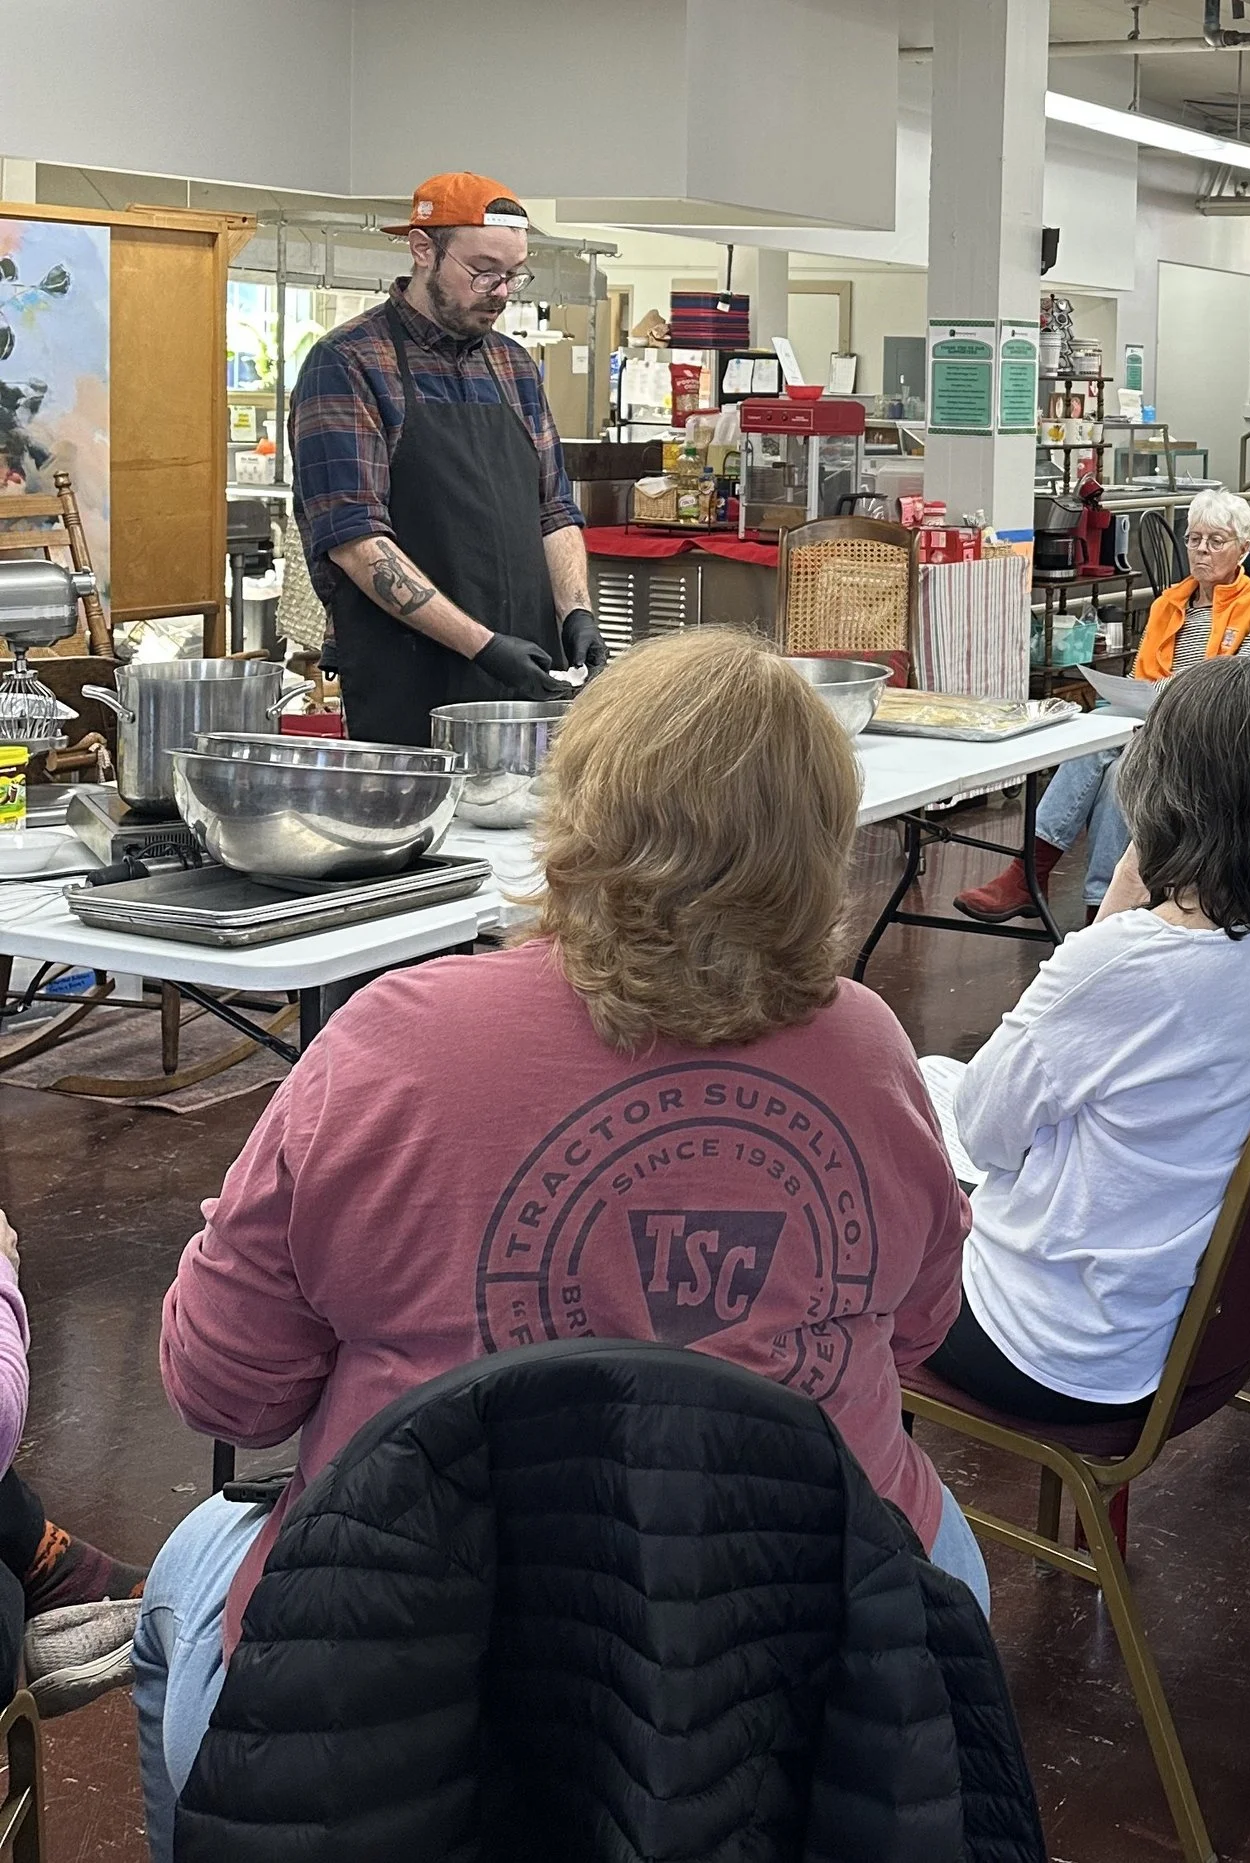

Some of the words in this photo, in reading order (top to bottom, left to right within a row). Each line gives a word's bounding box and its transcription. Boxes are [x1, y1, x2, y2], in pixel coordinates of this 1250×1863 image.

[505, 1088, 684, 1260] TRACTOR
[703, 1083, 843, 1173] SUPPLY
[837, 1190, 862, 1261] CO.
[612, 1138, 720, 1197] SINCE
[735, 1142, 802, 1198] 1938
[645, 1214, 757, 1322] TSC
